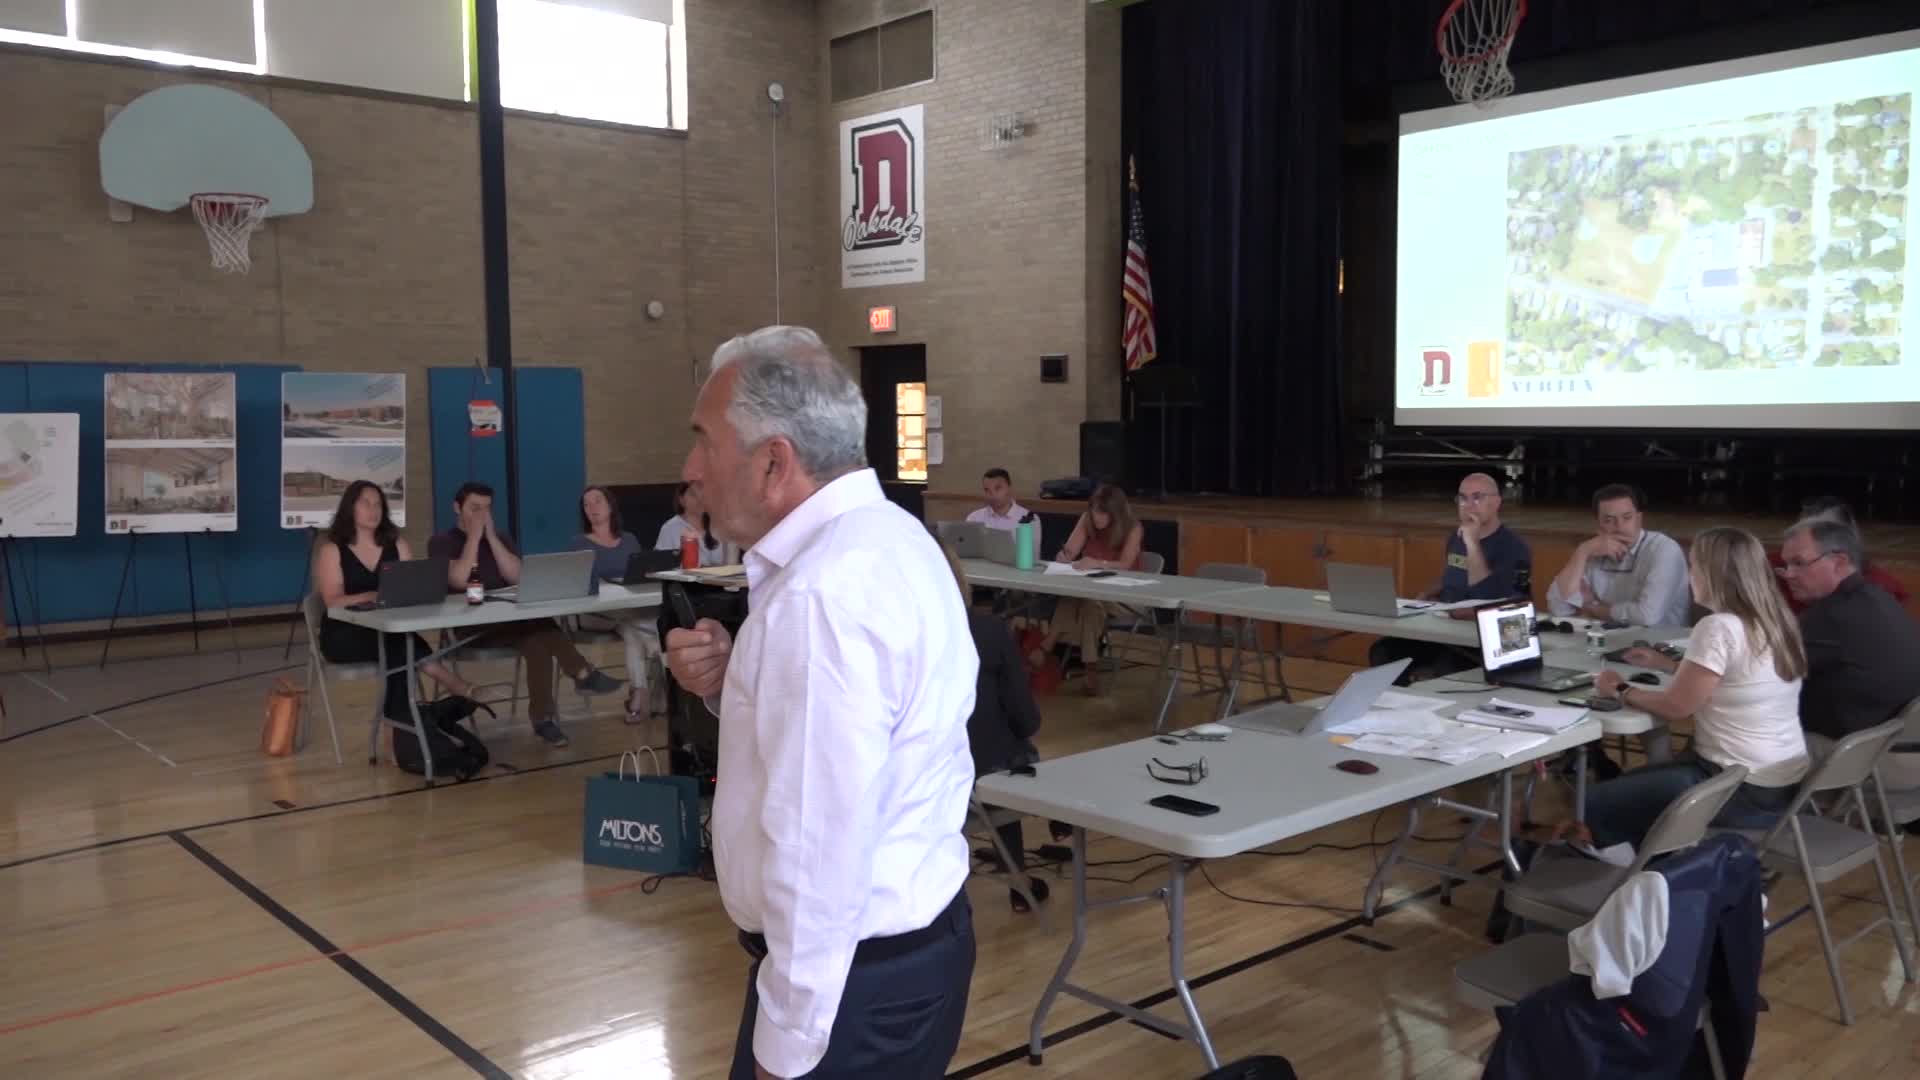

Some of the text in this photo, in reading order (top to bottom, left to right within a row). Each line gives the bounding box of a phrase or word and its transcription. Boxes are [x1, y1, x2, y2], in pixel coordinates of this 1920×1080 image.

[851, 117, 916, 250] D
[843, 204, 923, 252] Oakdale
[869, 309, 890, 329] EXIT
[599, 819, 663, 845] MILTONS
